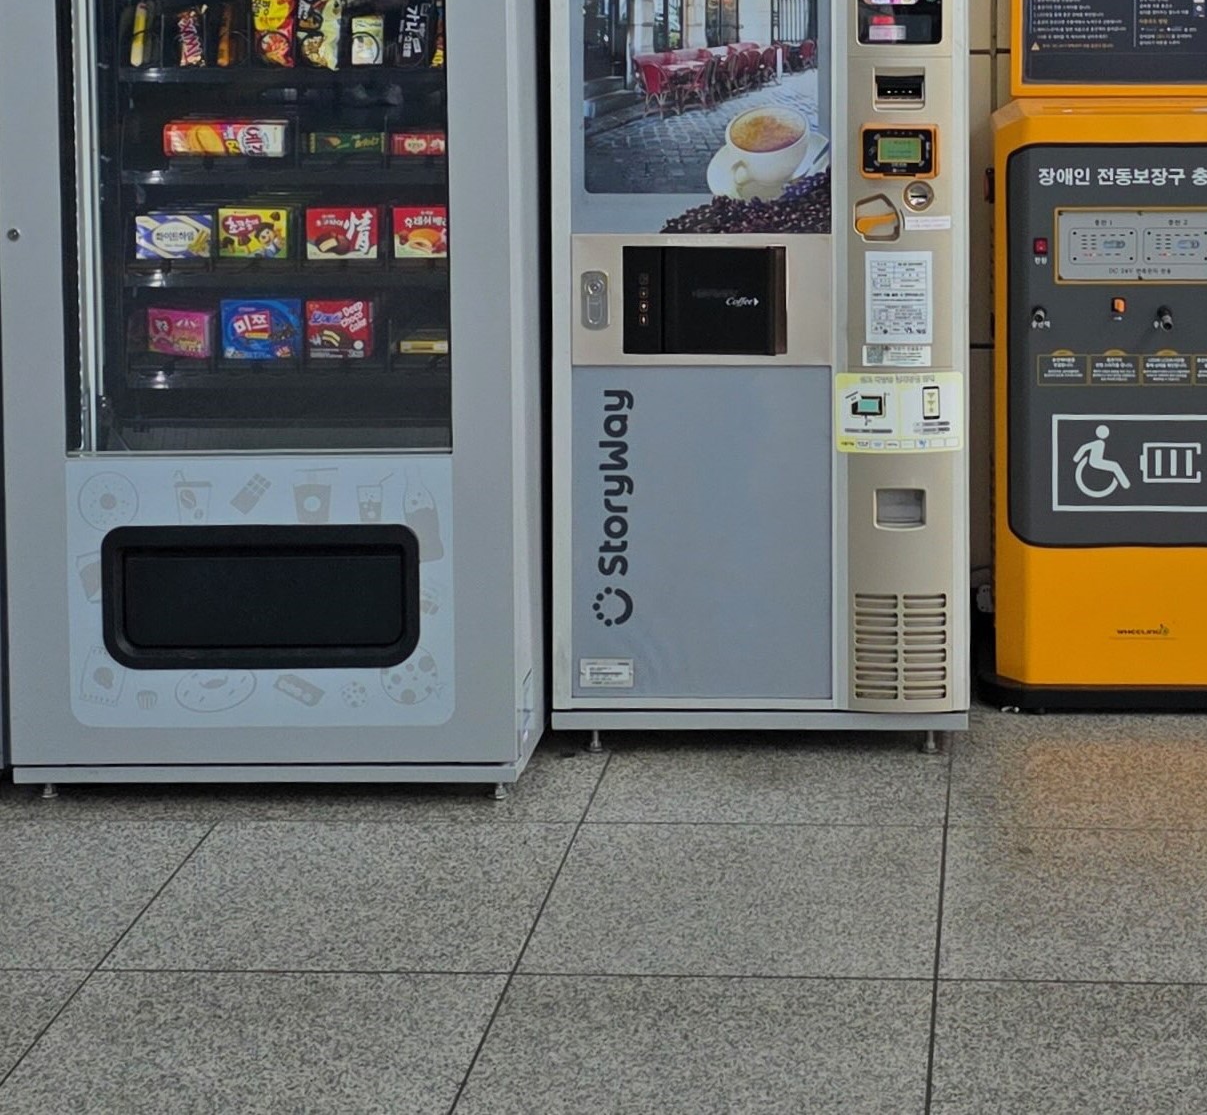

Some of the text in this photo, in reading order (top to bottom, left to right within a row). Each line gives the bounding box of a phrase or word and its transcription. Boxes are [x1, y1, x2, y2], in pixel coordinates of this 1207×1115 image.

[1038, 168, 1090, 185] 장애인
[1097, 168, 1186, 185] 전동보장구
[233, 314, 269, 333] 미쯔
[598, 389, 634, 576] StoryWay
